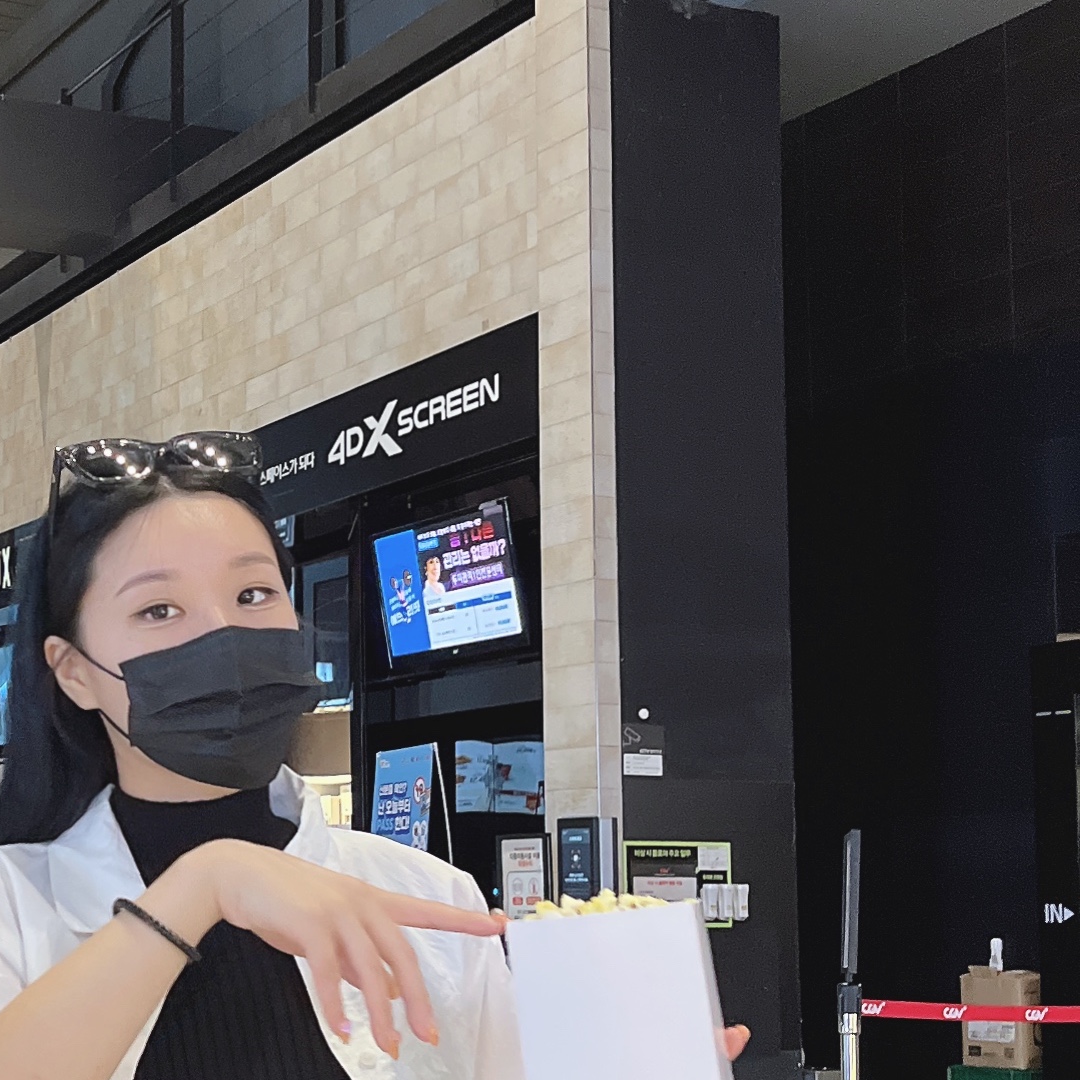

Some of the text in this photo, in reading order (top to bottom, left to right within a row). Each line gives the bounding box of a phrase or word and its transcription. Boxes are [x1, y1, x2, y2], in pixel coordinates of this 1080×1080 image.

[260, 457, 298, 486] 스페이스가
[298, 450, 316, 471] 되다
[397, 372, 500, 437] SCREEN
[1044, 903, 1063, 923] IN
